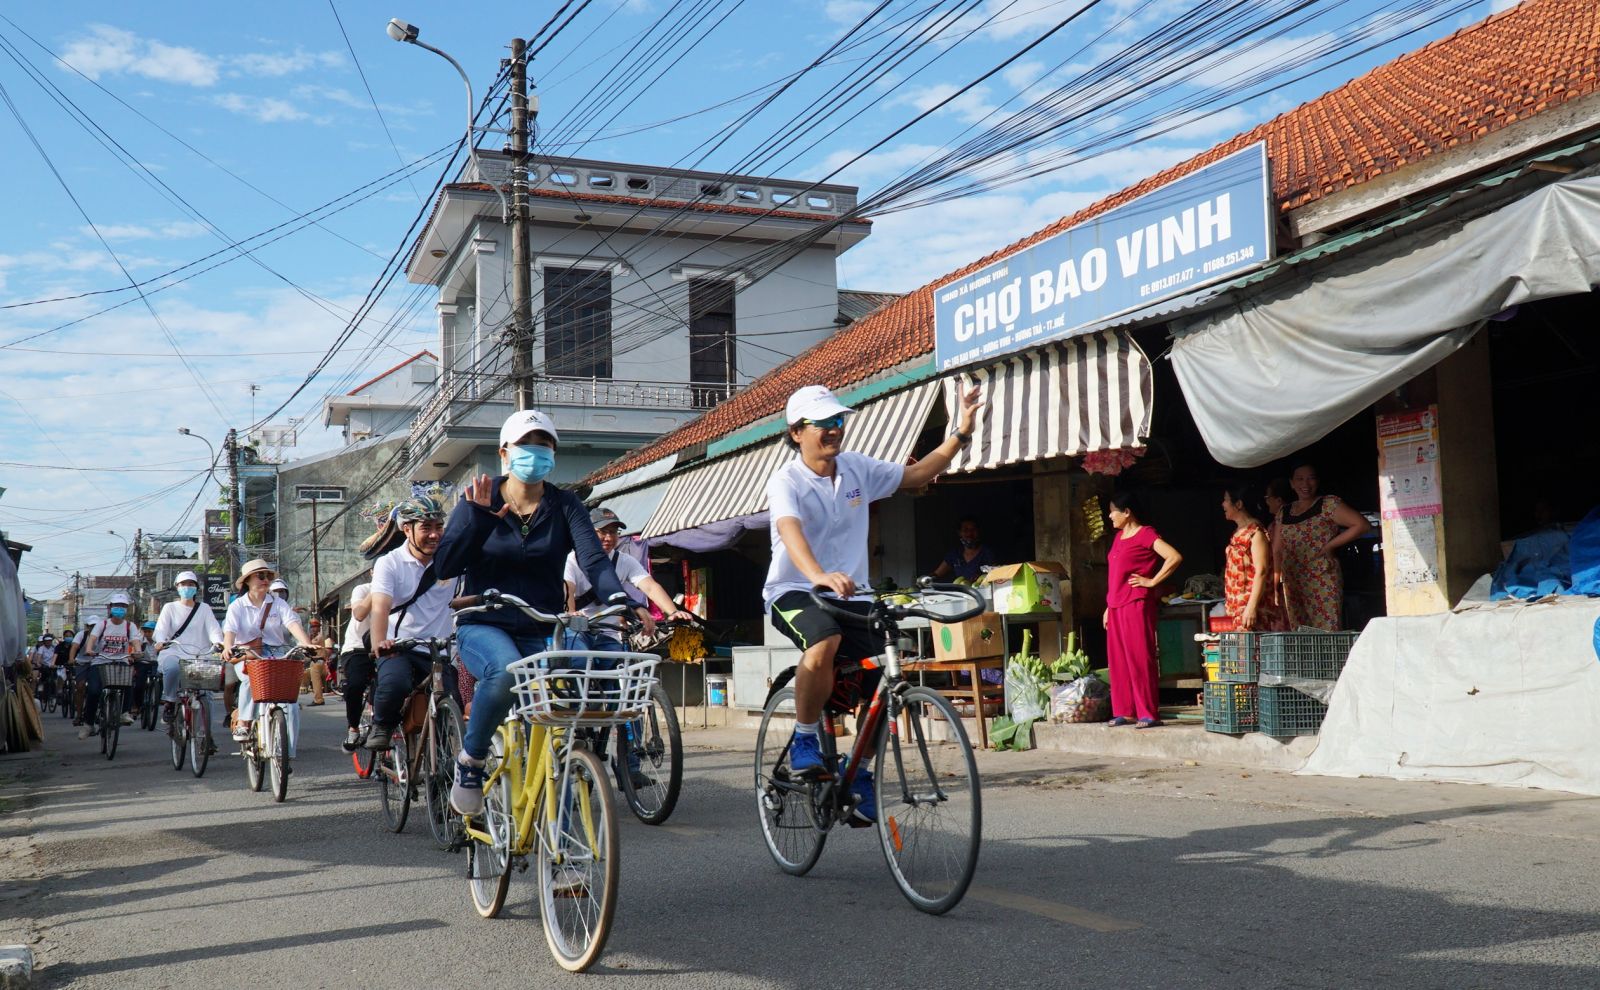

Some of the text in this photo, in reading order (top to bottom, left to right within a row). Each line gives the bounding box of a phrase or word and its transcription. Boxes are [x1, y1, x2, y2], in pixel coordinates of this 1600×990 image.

[954, 193, 1231, 342] CHỢ BAO VINH
[991, 266, 1009, 281] VINH
